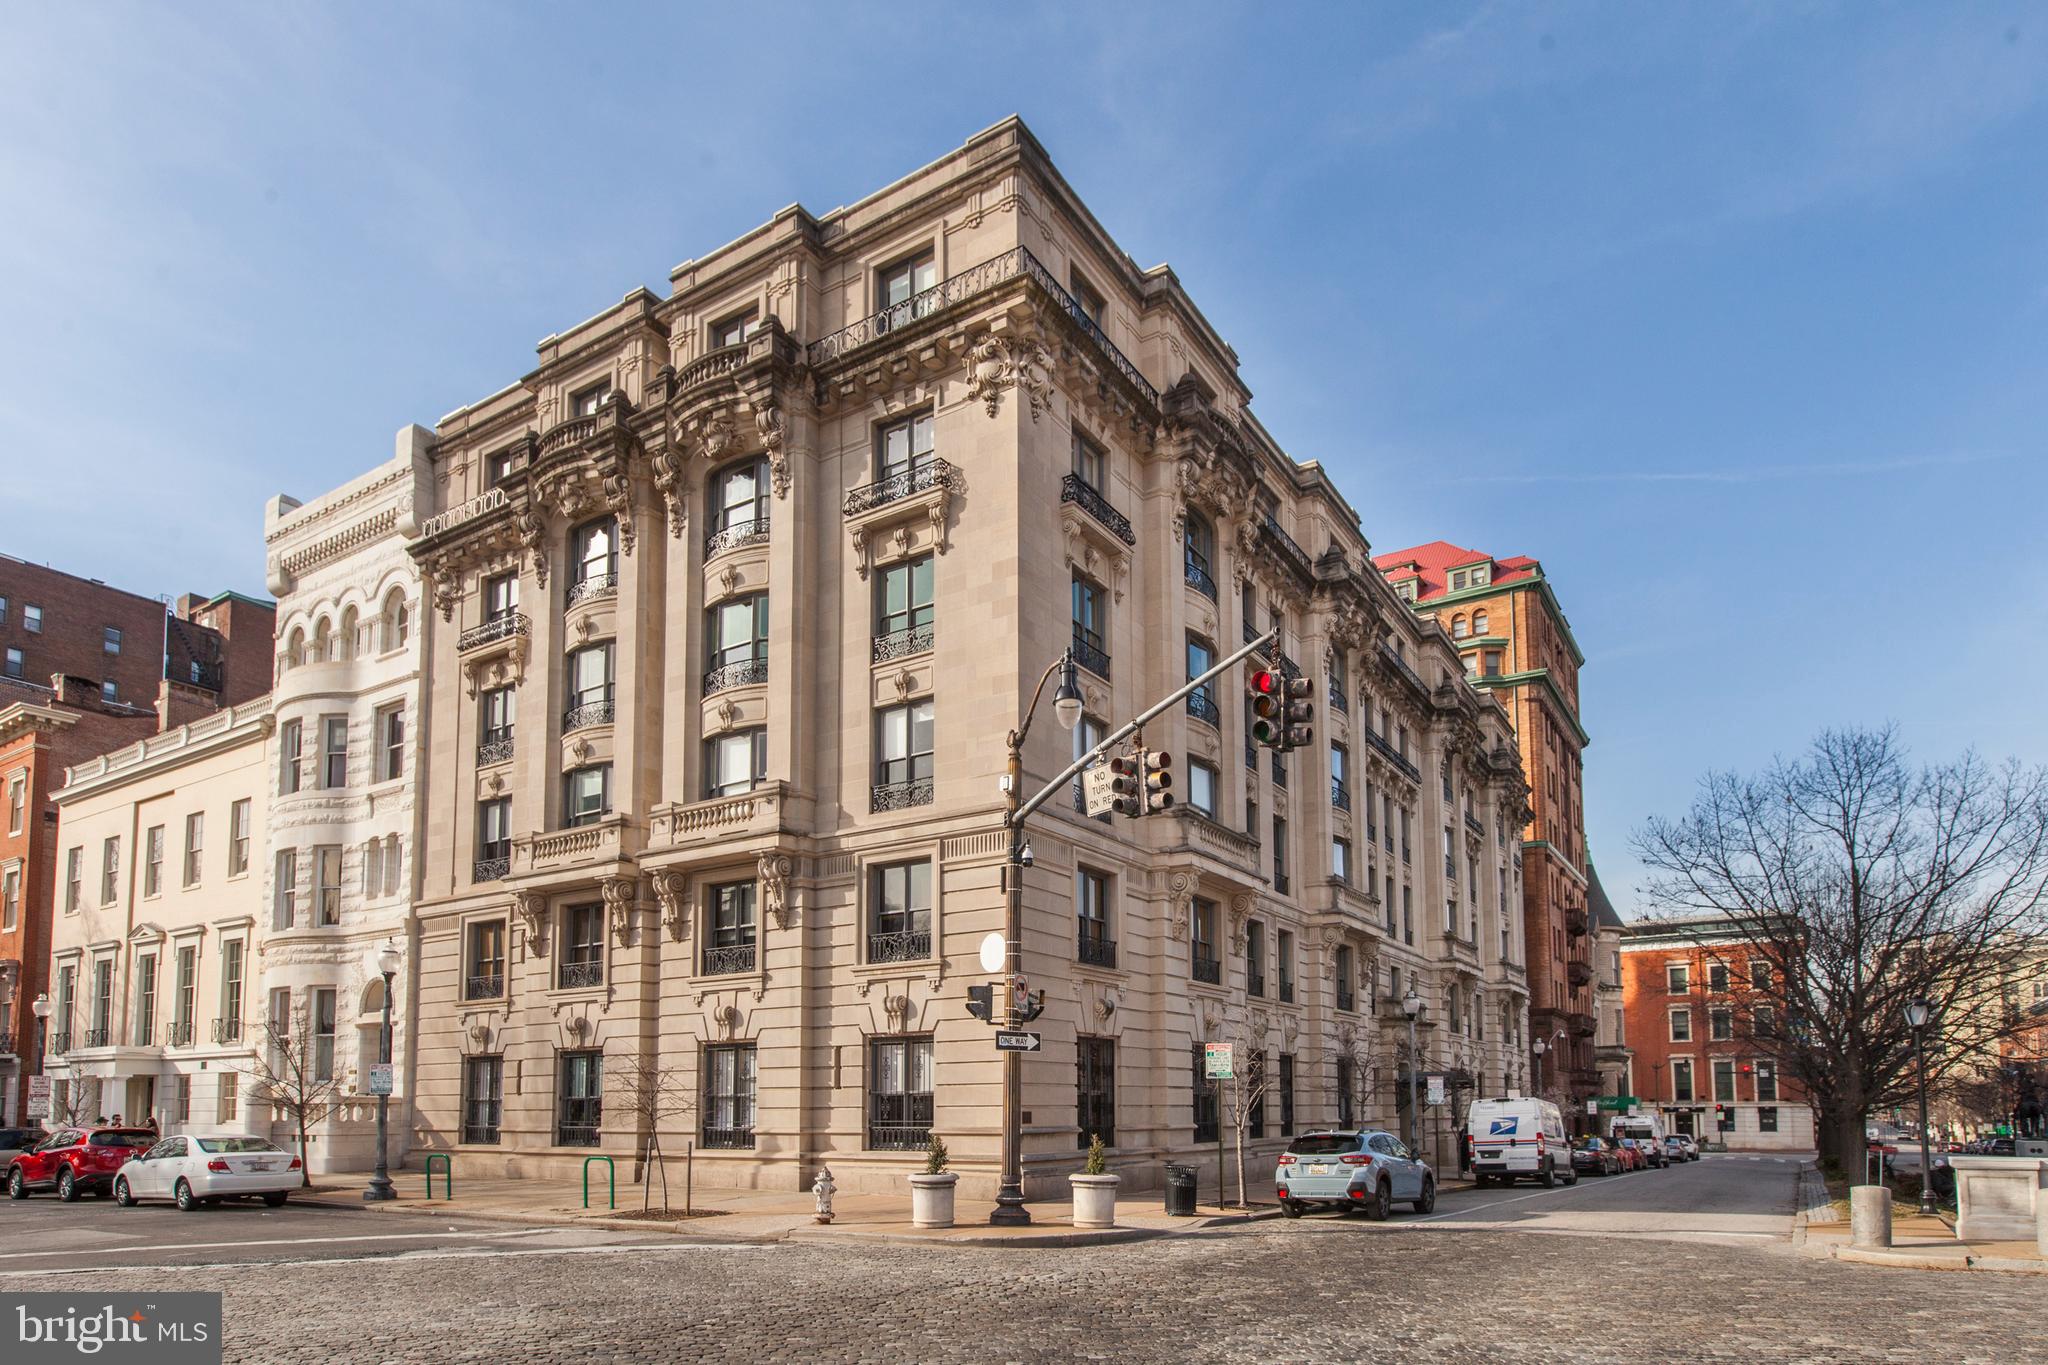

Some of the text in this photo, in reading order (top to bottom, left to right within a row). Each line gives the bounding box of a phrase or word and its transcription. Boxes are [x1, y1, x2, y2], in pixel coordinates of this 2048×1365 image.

[1094, 772, 1105, 782] NO
[1092, 783, 1110, 795] TURN
[1090, 799, 1098, 809] ON
[1000, 1036, 1028, 1046] ONE WAY
